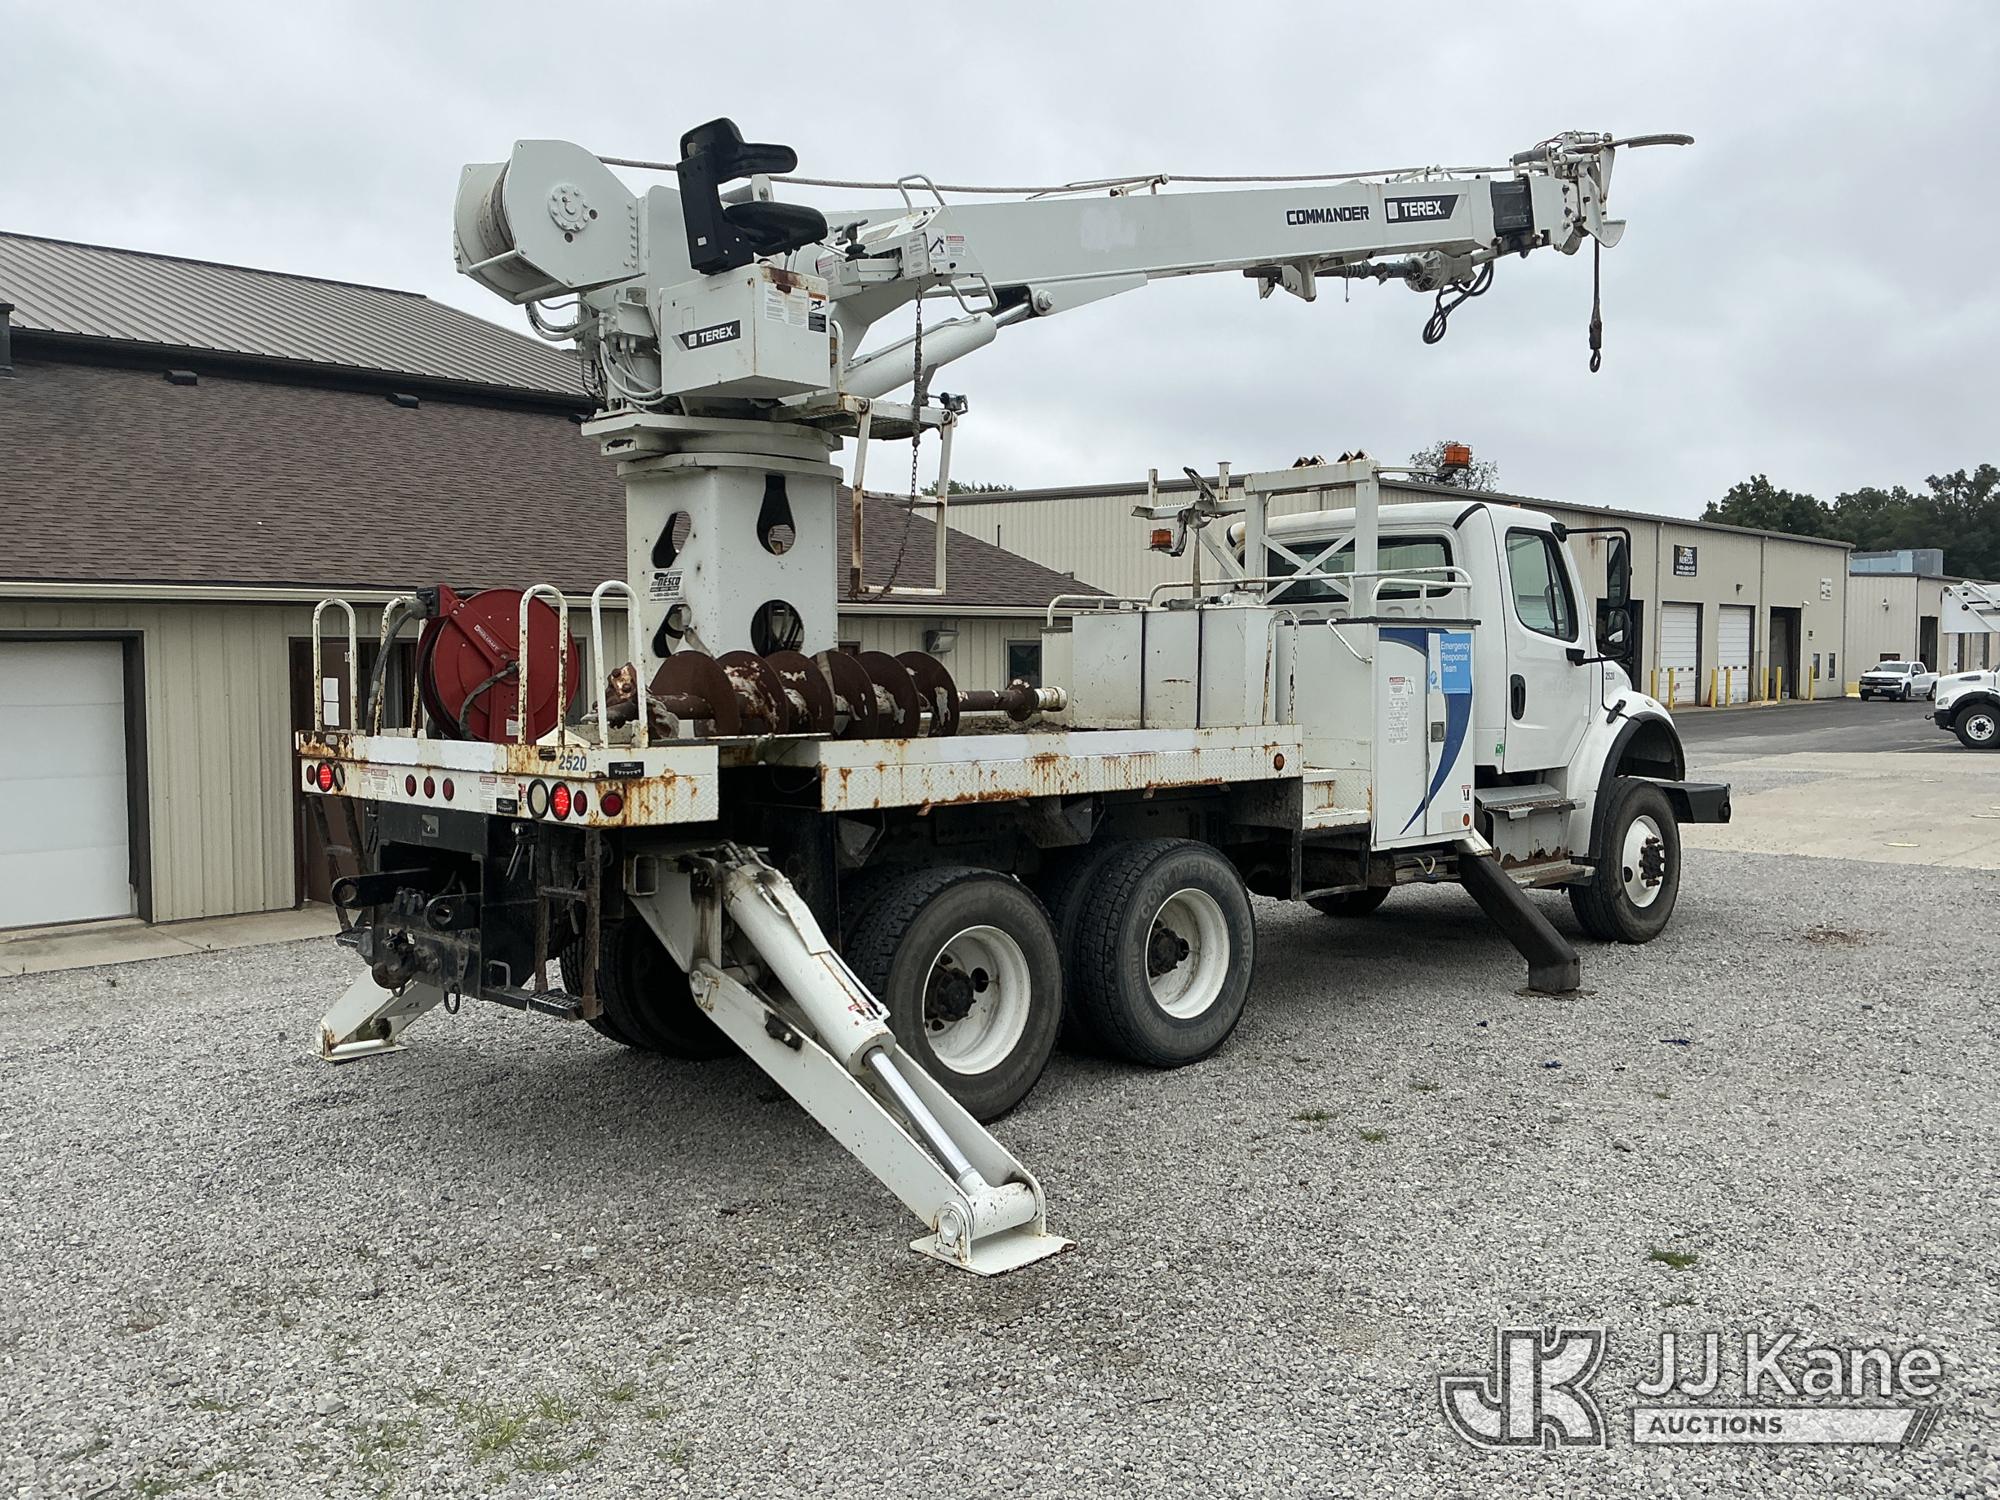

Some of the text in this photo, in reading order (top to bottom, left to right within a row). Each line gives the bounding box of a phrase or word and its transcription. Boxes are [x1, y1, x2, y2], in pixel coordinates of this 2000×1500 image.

[1286, 206, 1370, 226] COMMANDER
[1401, 200, 1443, 217] TEREX
[699, 325, 734, 344] TEREX
[1441, 641, 1470, 653] Emergency
[1441, 652, 1468, 663] Response
[1443, 663, 1458, 673] Team
[558, 753, 587, 772] 2520
